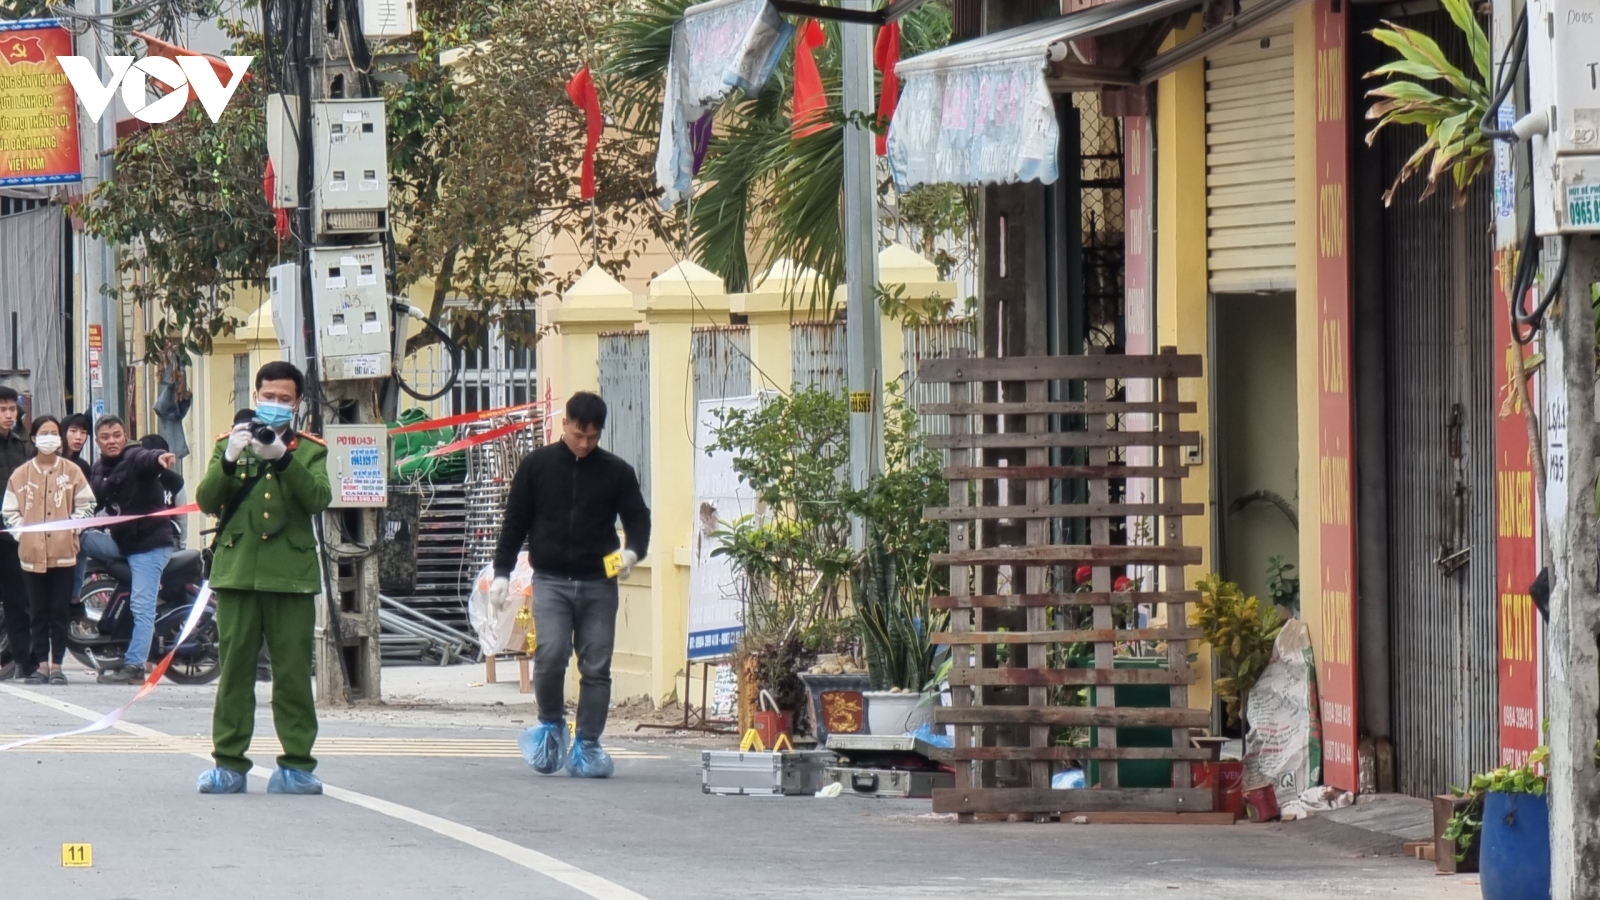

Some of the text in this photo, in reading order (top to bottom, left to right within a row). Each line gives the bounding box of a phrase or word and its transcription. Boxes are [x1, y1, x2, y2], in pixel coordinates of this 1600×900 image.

[16, 71, 32, 89] SẢN
[33, 72, 48, 91] VIỆT
[50, 73, 67, 87] NAM
[16, 93, 36, 109] LÃNH
[12, 117, 27, 132] MỌI
[28, 111, 54, 129] THẮNG
[56, 113, 70, 129] LỢI
[33, 135, 57, 153] MẠNG
[8, 157, 45, 174] VIỆT NAM
[1570, 200, 1600, 226] 0965.8
[69, 845, 84, 861] 11
